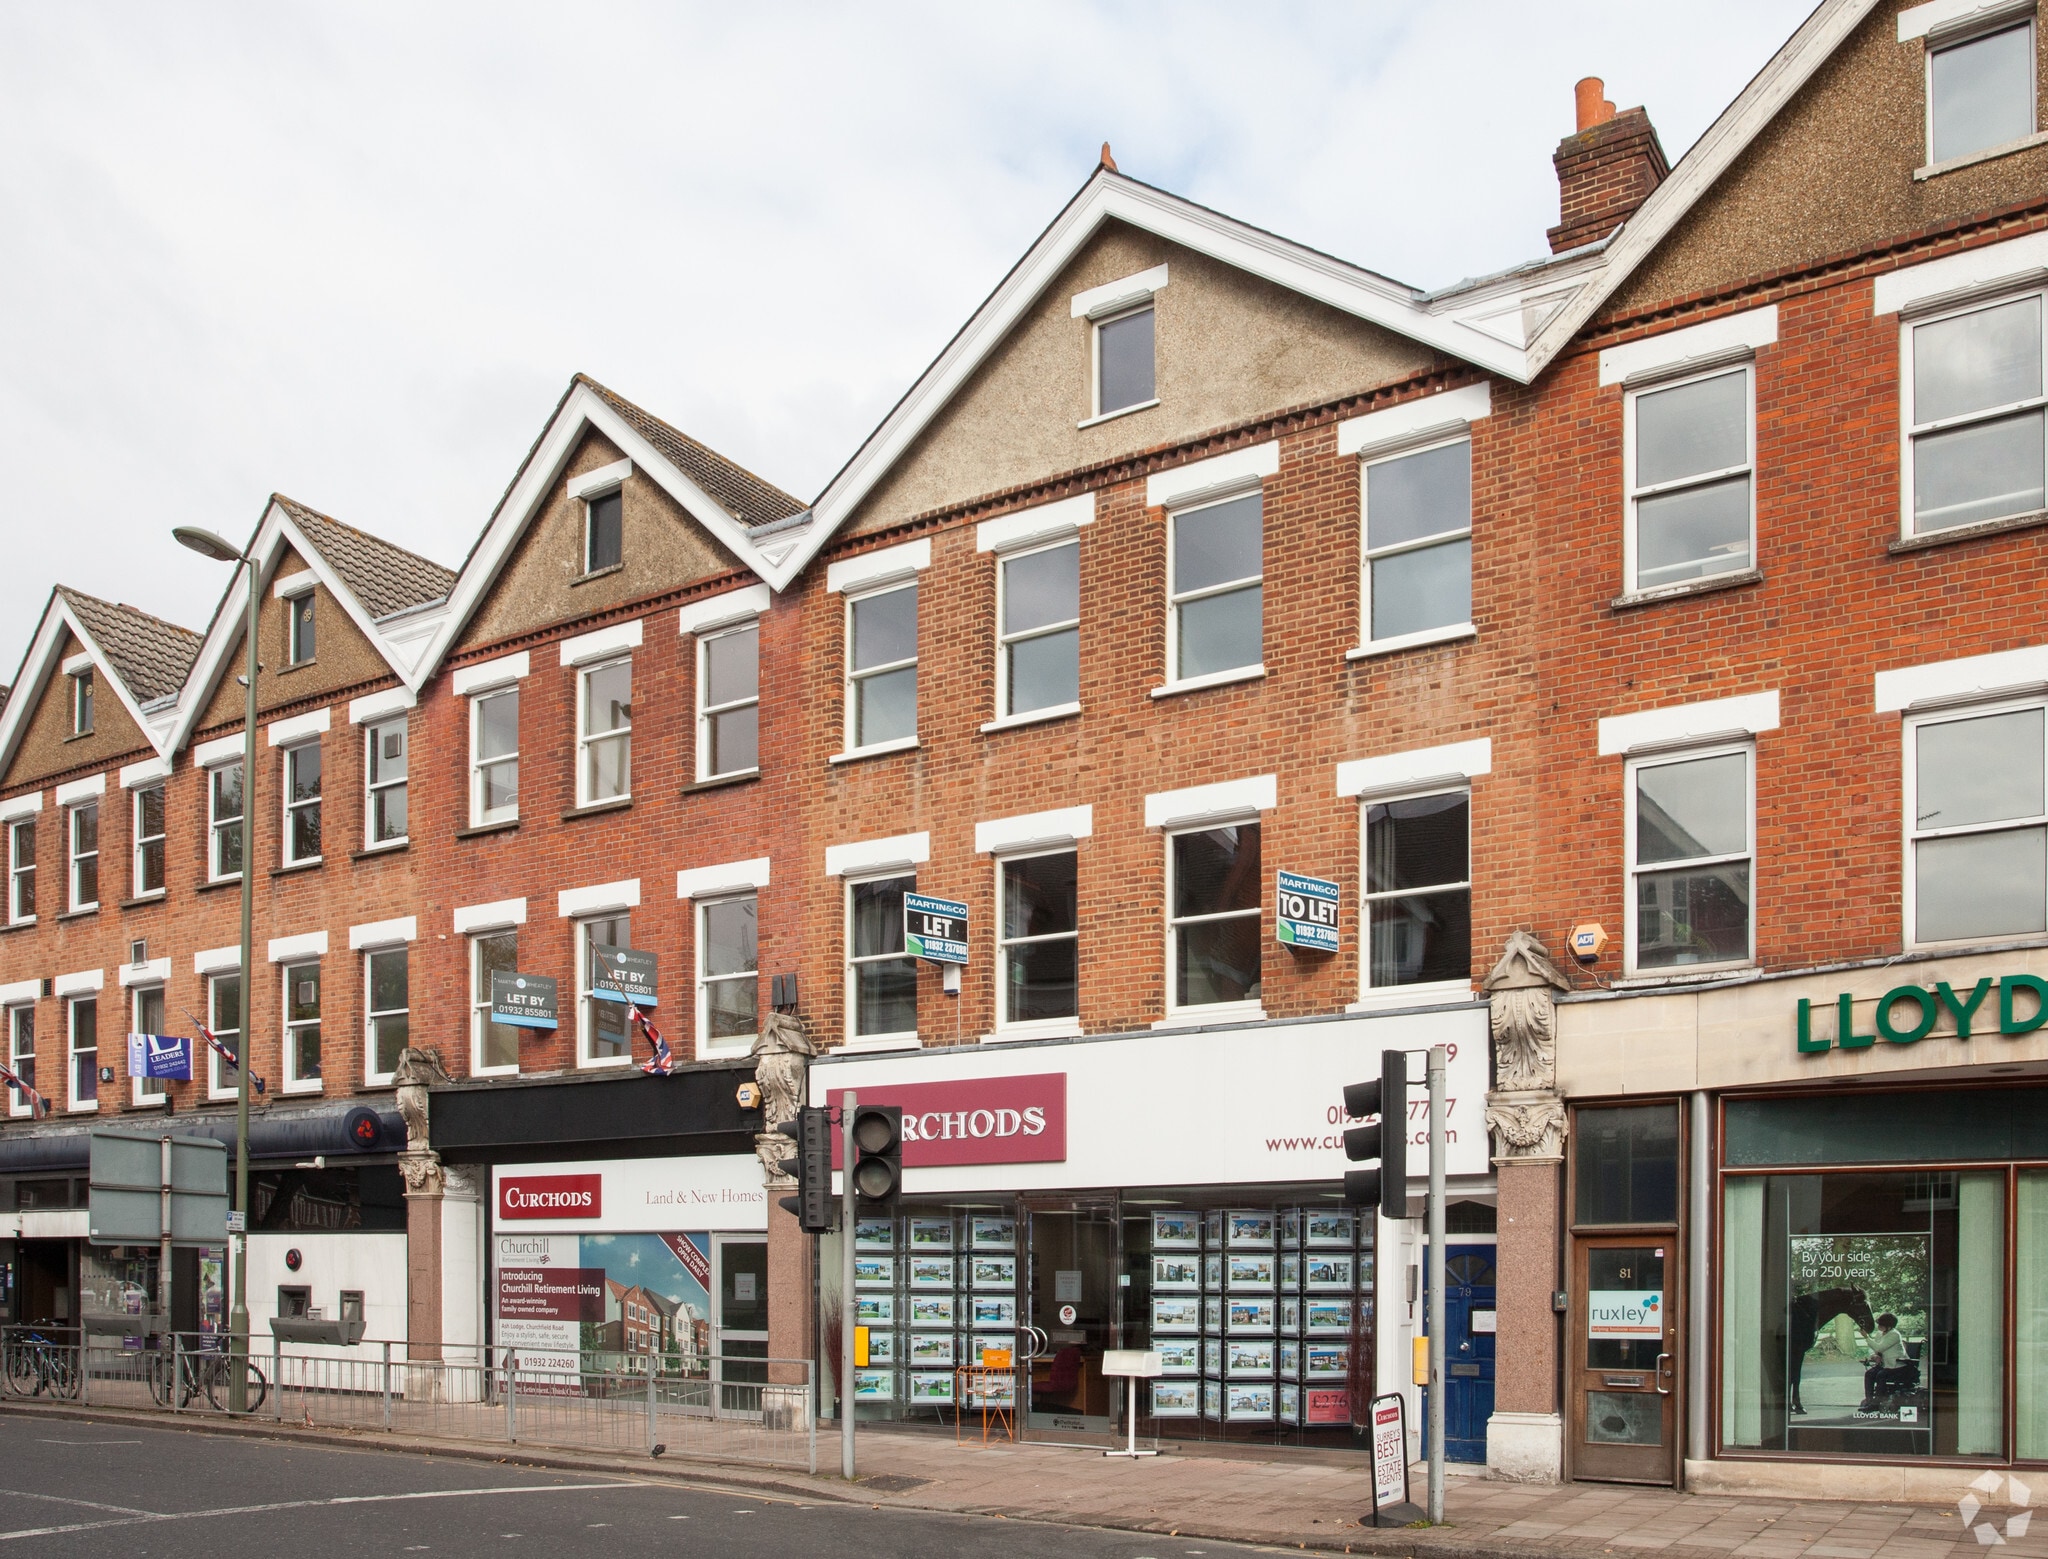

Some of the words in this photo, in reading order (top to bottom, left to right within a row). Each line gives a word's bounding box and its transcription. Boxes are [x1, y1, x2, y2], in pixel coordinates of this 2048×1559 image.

[1280, 876, 1338, 896] MARTIN&CO
[907, 896, 966, 915] MARTIN&CO
[1280, 892, 1305, 919] TO
[1309, 899, 1337, 925] LET
[923, 914, 953, 938] LET
[1578, 935, 1594, 945] ADT
[630, 971, 645, 983] BY
[624, 984, 652, 995] 855801
[507, 993, 527, 1005] LET
[530, 995, 545, 1007] BY
[498, 1004, 523, 1016] 01932
[524, 1007, 552, 1018] 855801
[1797, 974, 2048, 1053] LLOYD
[150, 1050, 184, 1063] LEADERS
[505, 1186, 592, 1209] CURCHODS
[646, 1190, 673, 1205] Land
[676, 1191, 687, 1204] &
[690, 1188, 718, 1204] New
[721, 1188, 764, 1203] Homes
[501, 1238, 549, 1254] Churchill
[676, 1234, 693, 1254] SHOW
[677, 1246, 691, 1263] OPEN
[689, 1261, 704, 1277] DAILY
[1802, 1251, 1817, 1265] By
[1818, 1253, 1845, 1265] your
[501, 1271, 543, 1283] Introducing
[1619, 1268, 1632, 1278] 81
[1802, 1266, 1818, 1278] for
[1820, 1266, 1842, 1278] 250
[1844, 1268, 1876, 1280] years
[501, 1283, 533, 1294] Churchill
[534, 1284, 576, 1295] Retirement
[577, 1285, 601, 1297] Living
[1458, 1287, 1472, 1297] 79
[510, 1297, 547, 1306] award-winning
[501, 1305, 517, 1313] family
[536, 1307, 558, 1315] company
[1592, 1305, 1647, 1325] ruxley
[501, 1331, 515, 1339] Enjoy
[524, 1357, 546, 1367] 01932
[548, 1358, 575, 1369] 224260
[1376, 1428, 1400, 1443] SURREY'S
[1377, 1438, 1400, 1460] BEST
[1378, 1460, 1401, 1477] ESTATE
[1378, 1471, 1401, 1488] AGENTS
